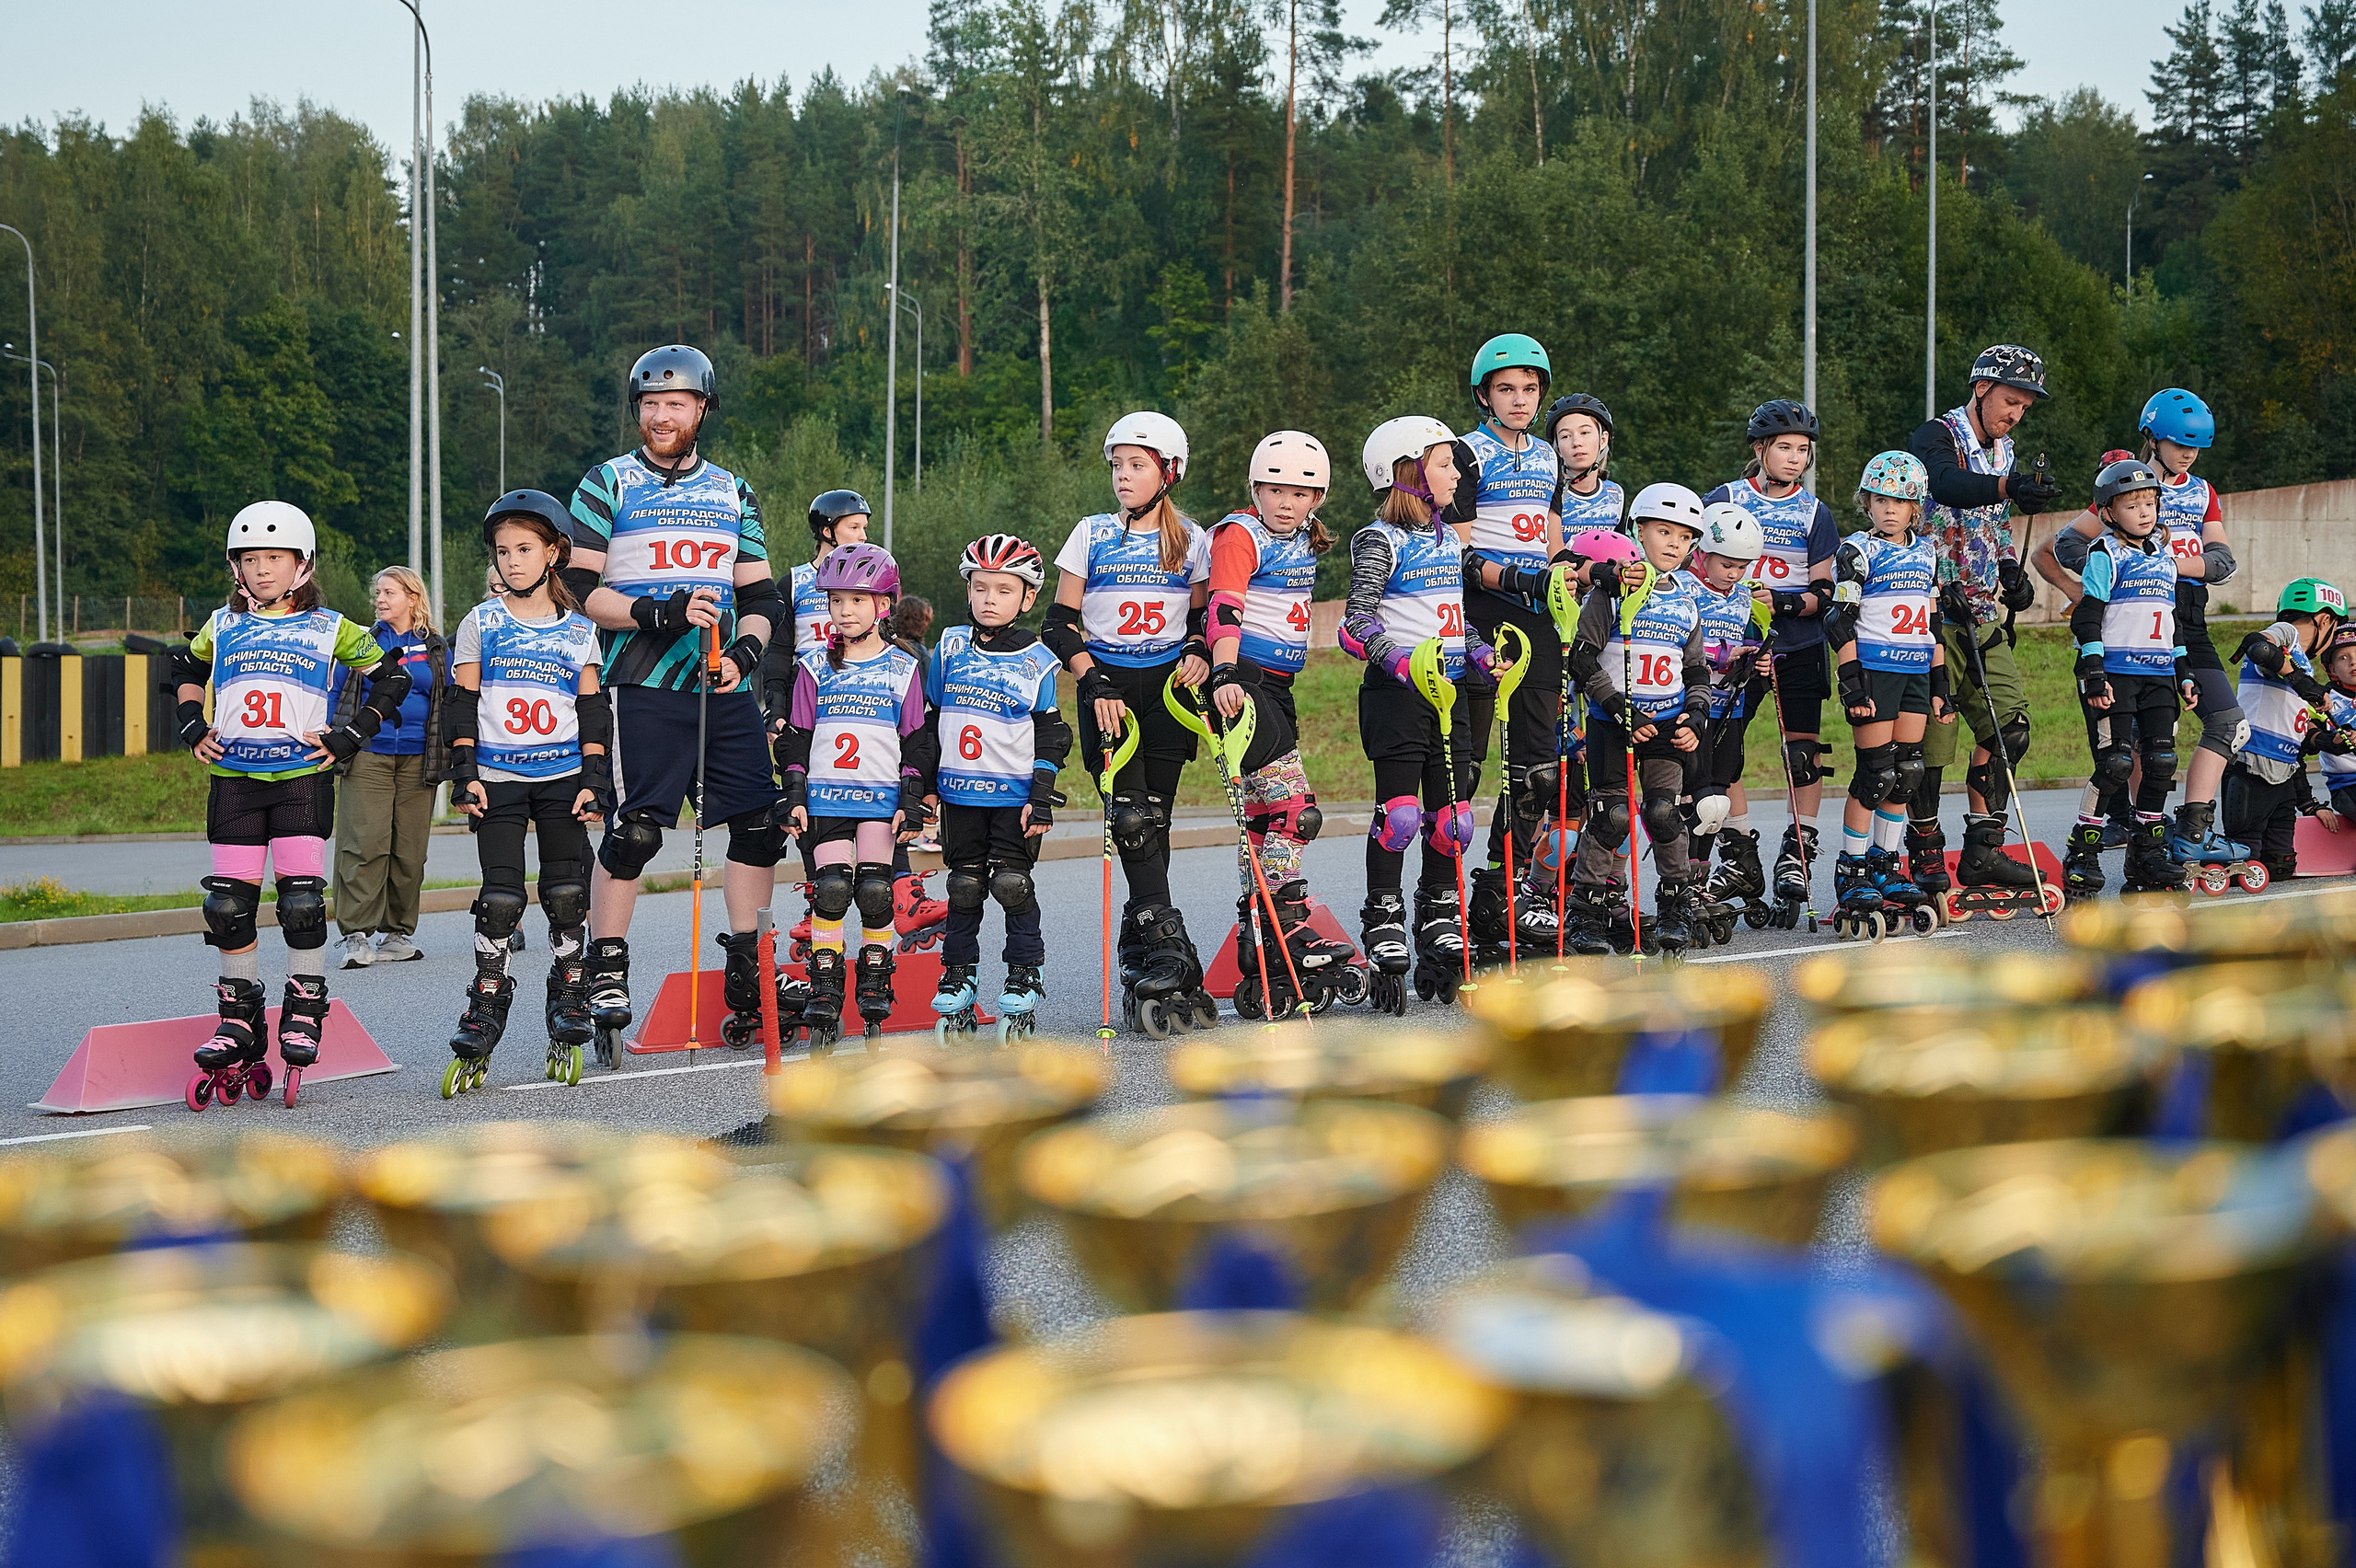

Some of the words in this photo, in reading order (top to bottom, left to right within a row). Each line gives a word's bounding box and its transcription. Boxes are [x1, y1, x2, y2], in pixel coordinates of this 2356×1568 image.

[1508, 490, 1547, 499] ОБЛАСТЬ
[629, 508, 736, 524] ЛЕНИНГРАДСКАЯ
[657, 517, 719, 528] ОБЛАСТЬ
[1511, 513, 1548, 544] 98
[649, 539, 731, 570] 107
[1094, 563, 1187, 577] ЛЕНИНГРАДЯ
[1752, 556, 1790, 579] 78
[1116, 574, 1169, 584] ОБЛАСТЬ
[1425, 577, 1461, 588] ОБЛАСТЬ
[2320, 588, 2341, 606] 109
[1117, 601, 1166, 635] 25
[1438, 603, 1464, 637] 21
[1891, 605, 1928, 635] 24
[2149, 611, 2163, 640] 1
[1636, 629, 1680, 643] ОБЛАСТЬ
[1708, 628, 1742, 641] ОБЛАСТЬ
[1890, 650, 1925, 662] 47.reg
[2132, 655, 2170, 666] 47.reg
[240, 661, 294, 675] ОБЛАСТЬ
[506, 669, 558, 684] ОБЛАСТЬ
[1636, 654, 1673, 686] 16
[1426, 669, 1439, 698] LEKI
[241, 689, 285, 729] 31
[955, 695, 1002, 713] ОБЛАСТЬ
[504, 698, 558, 735] 30
[2294, 709, 2308, 735] 6
[834, 732, 861, 770] 2
[959, 724, 982, 760] 6
[237, 744, 291, 760] 47.reg
[949, 778, 997, 793] 47.reg
[1501, 760, 1510, 795] LEKI
[696, 780, 704, 820] WAY
[820, 788, 875, 803] 47.reg
